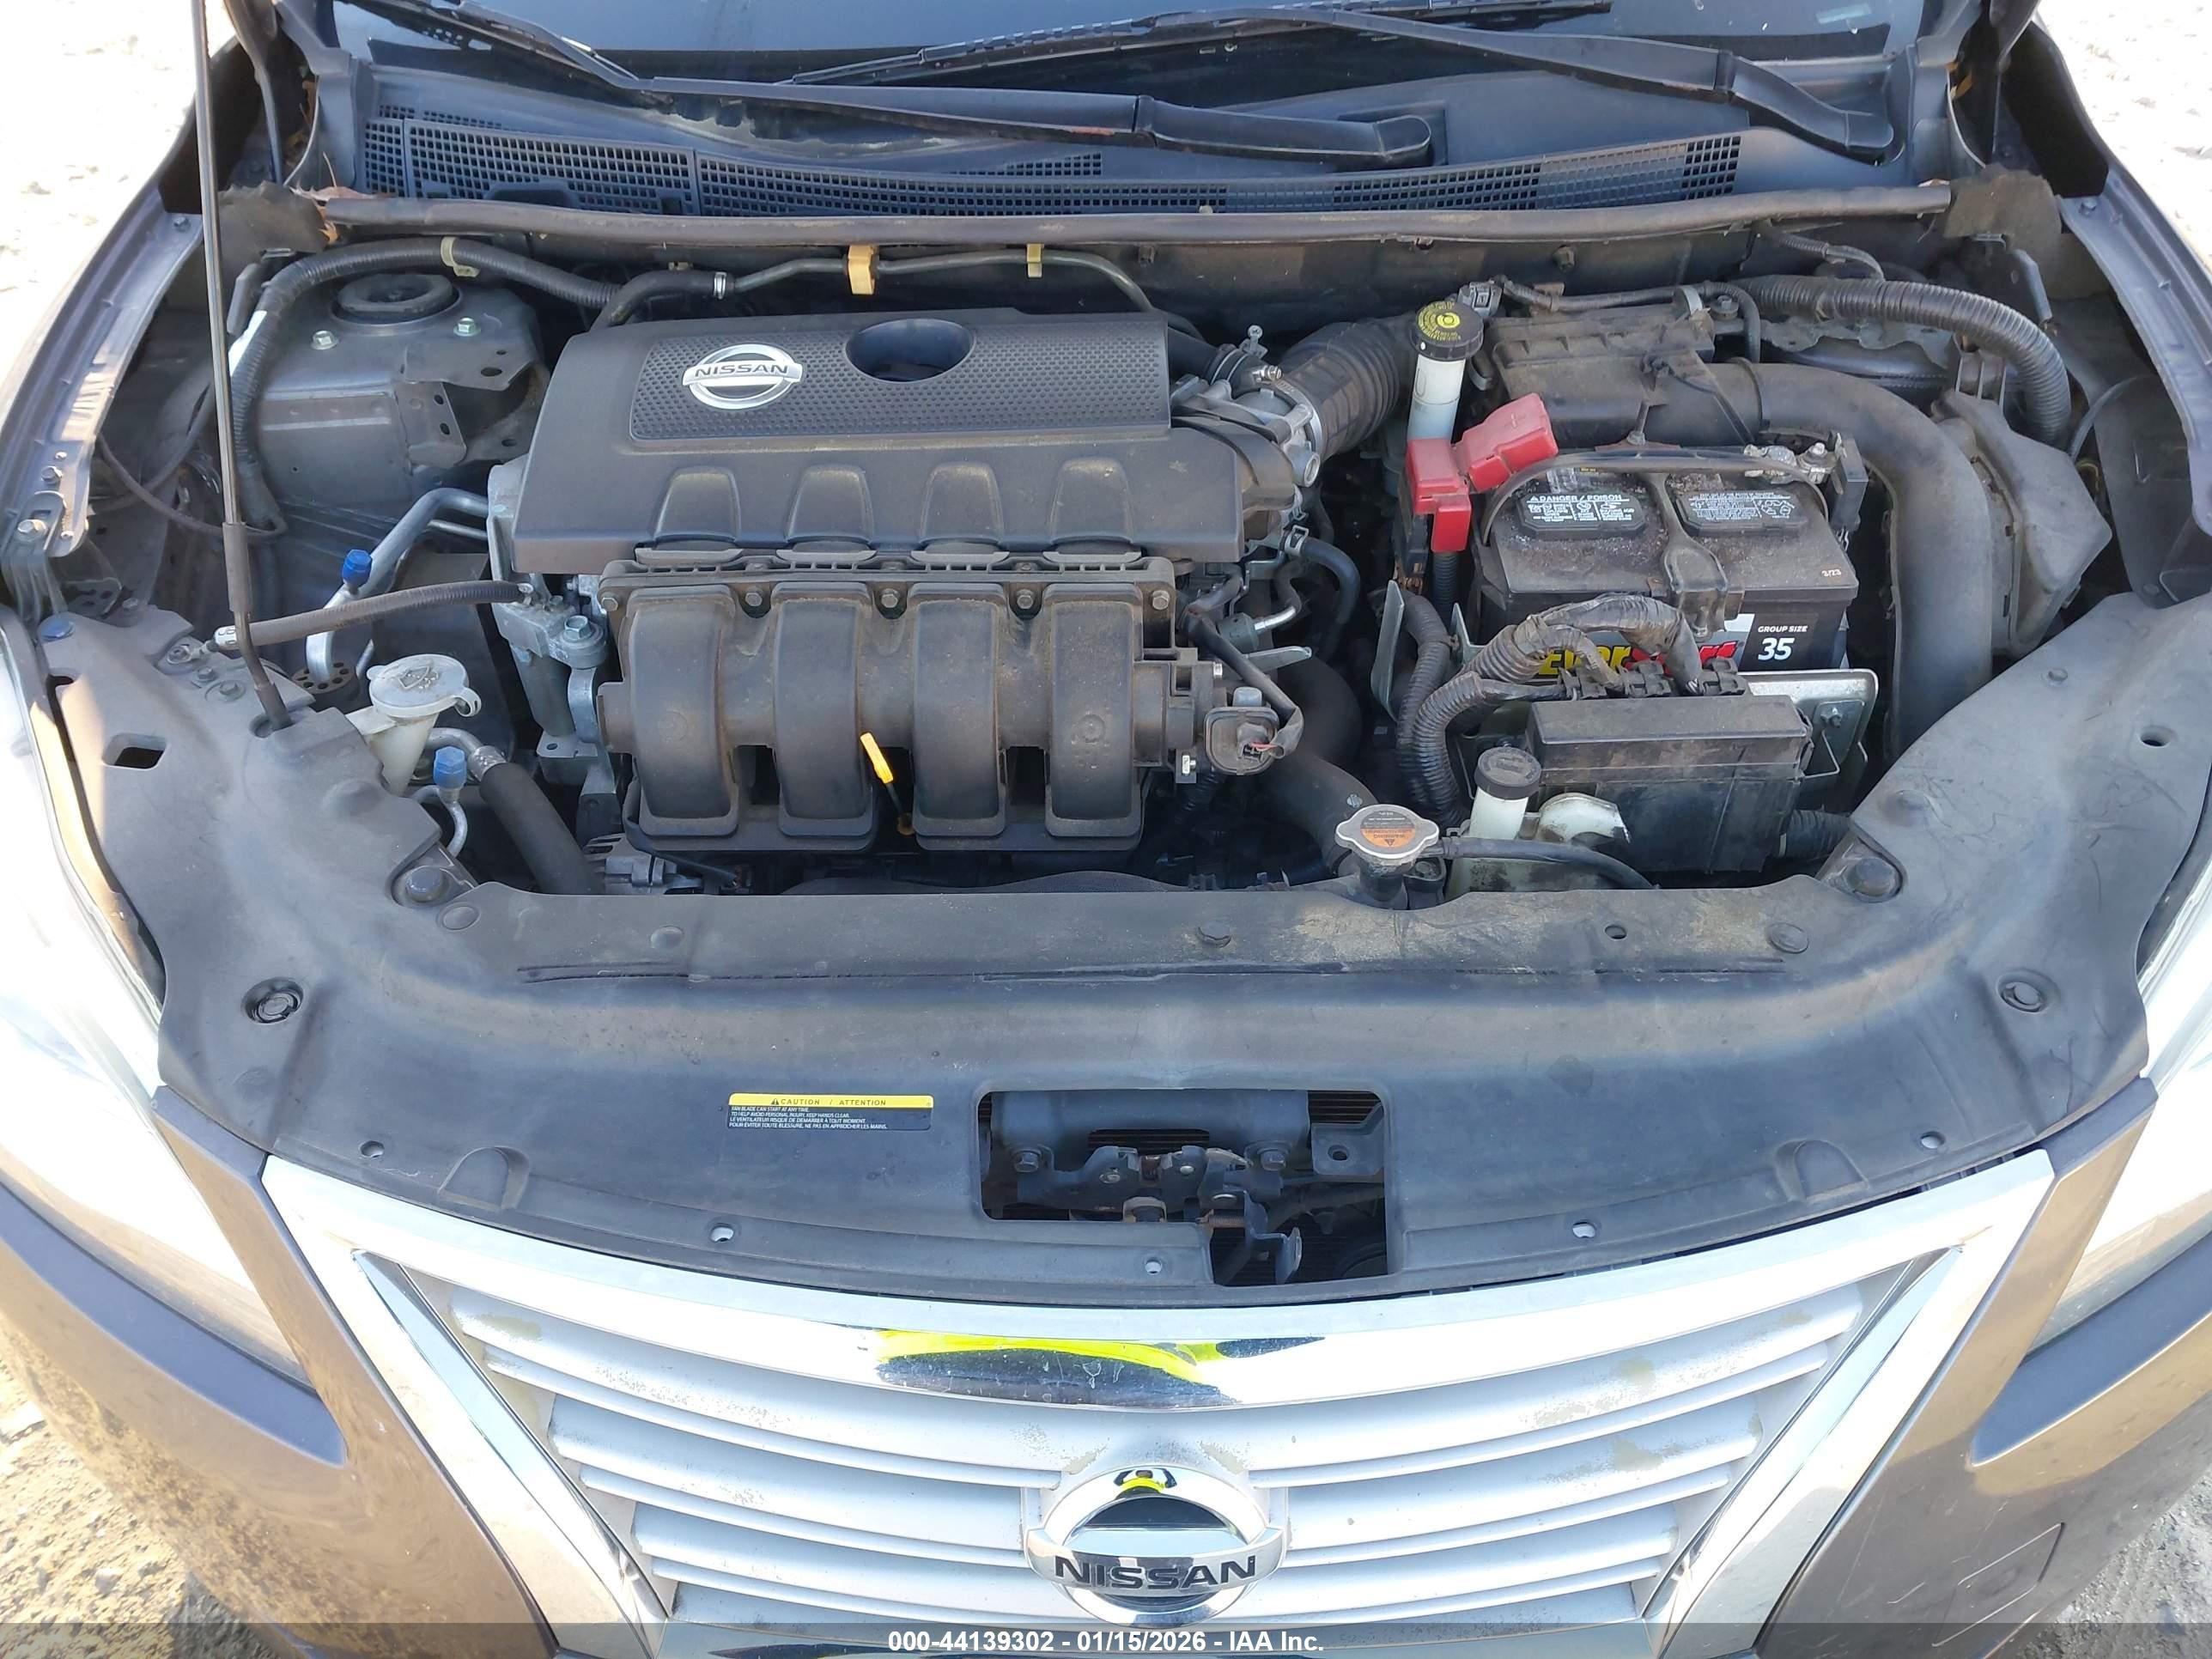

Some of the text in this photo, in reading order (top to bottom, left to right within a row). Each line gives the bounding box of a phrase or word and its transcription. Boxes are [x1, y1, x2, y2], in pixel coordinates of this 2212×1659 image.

[694, 364, 788, 378] NISSAN
[1758, 637, 1795, 660] 35
[1054, 1555, 1255, 1589] NISSAN
